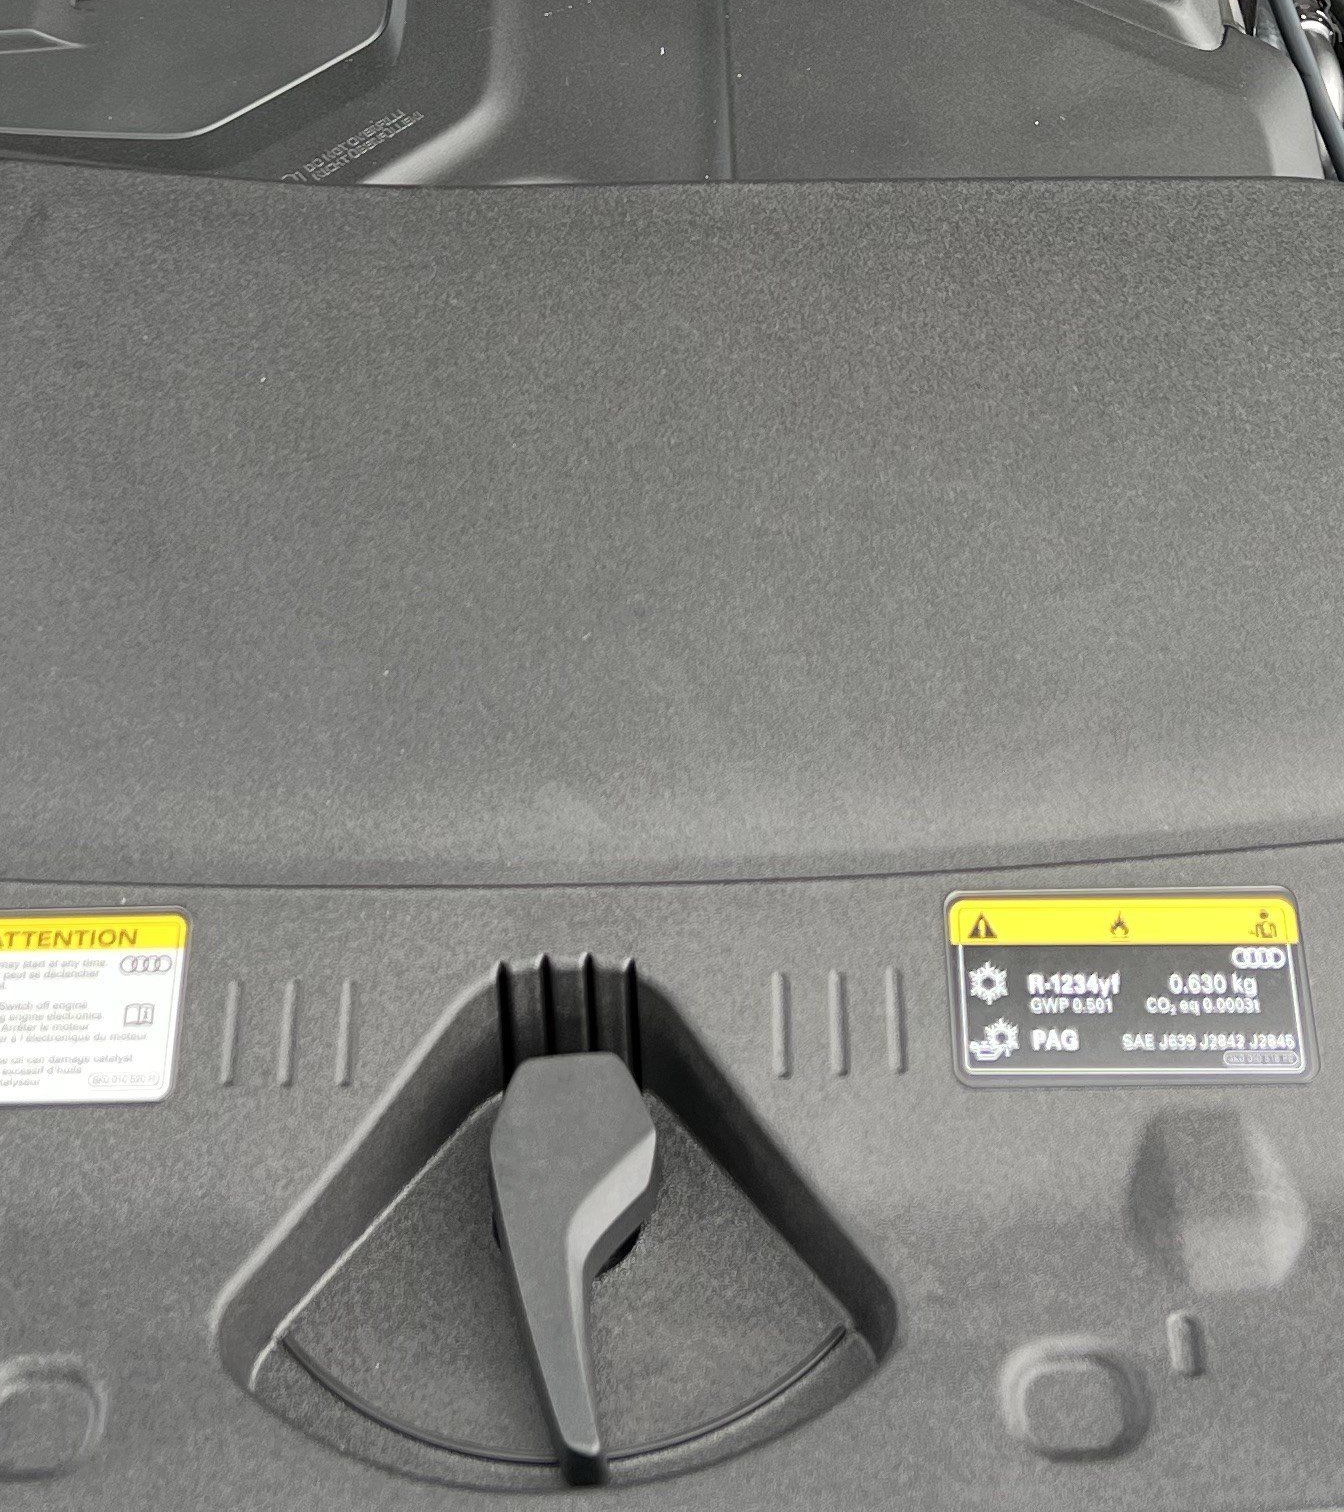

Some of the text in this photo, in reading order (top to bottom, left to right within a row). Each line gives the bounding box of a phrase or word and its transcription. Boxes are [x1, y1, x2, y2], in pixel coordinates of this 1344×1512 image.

[22, 960, 46, 969] start
[60, 960, 80, 970] any
[3, 971, 27, 982] peut
[29, 972, 41, 980] se
[1026, 971, 1258, 997] R-1234yf 0.630 kg
[36, 1000, 51, 1010] off
[52, 1001, 88, 1012] engine
[1030, 997, 1070, 1014] GWP
[1072, 996, 1114, 1014] 0.501
[1179, 999, 1201, 1016] eq
[8, 1013, 45, 1024] engine
[1030, 1029, 1080, 1052] PAG
[1122, 1033, 1156, 1051] SAE
[1158, 1033, 1197, 1051] J639
[1199, 1033, 1246, 1051] J2842
